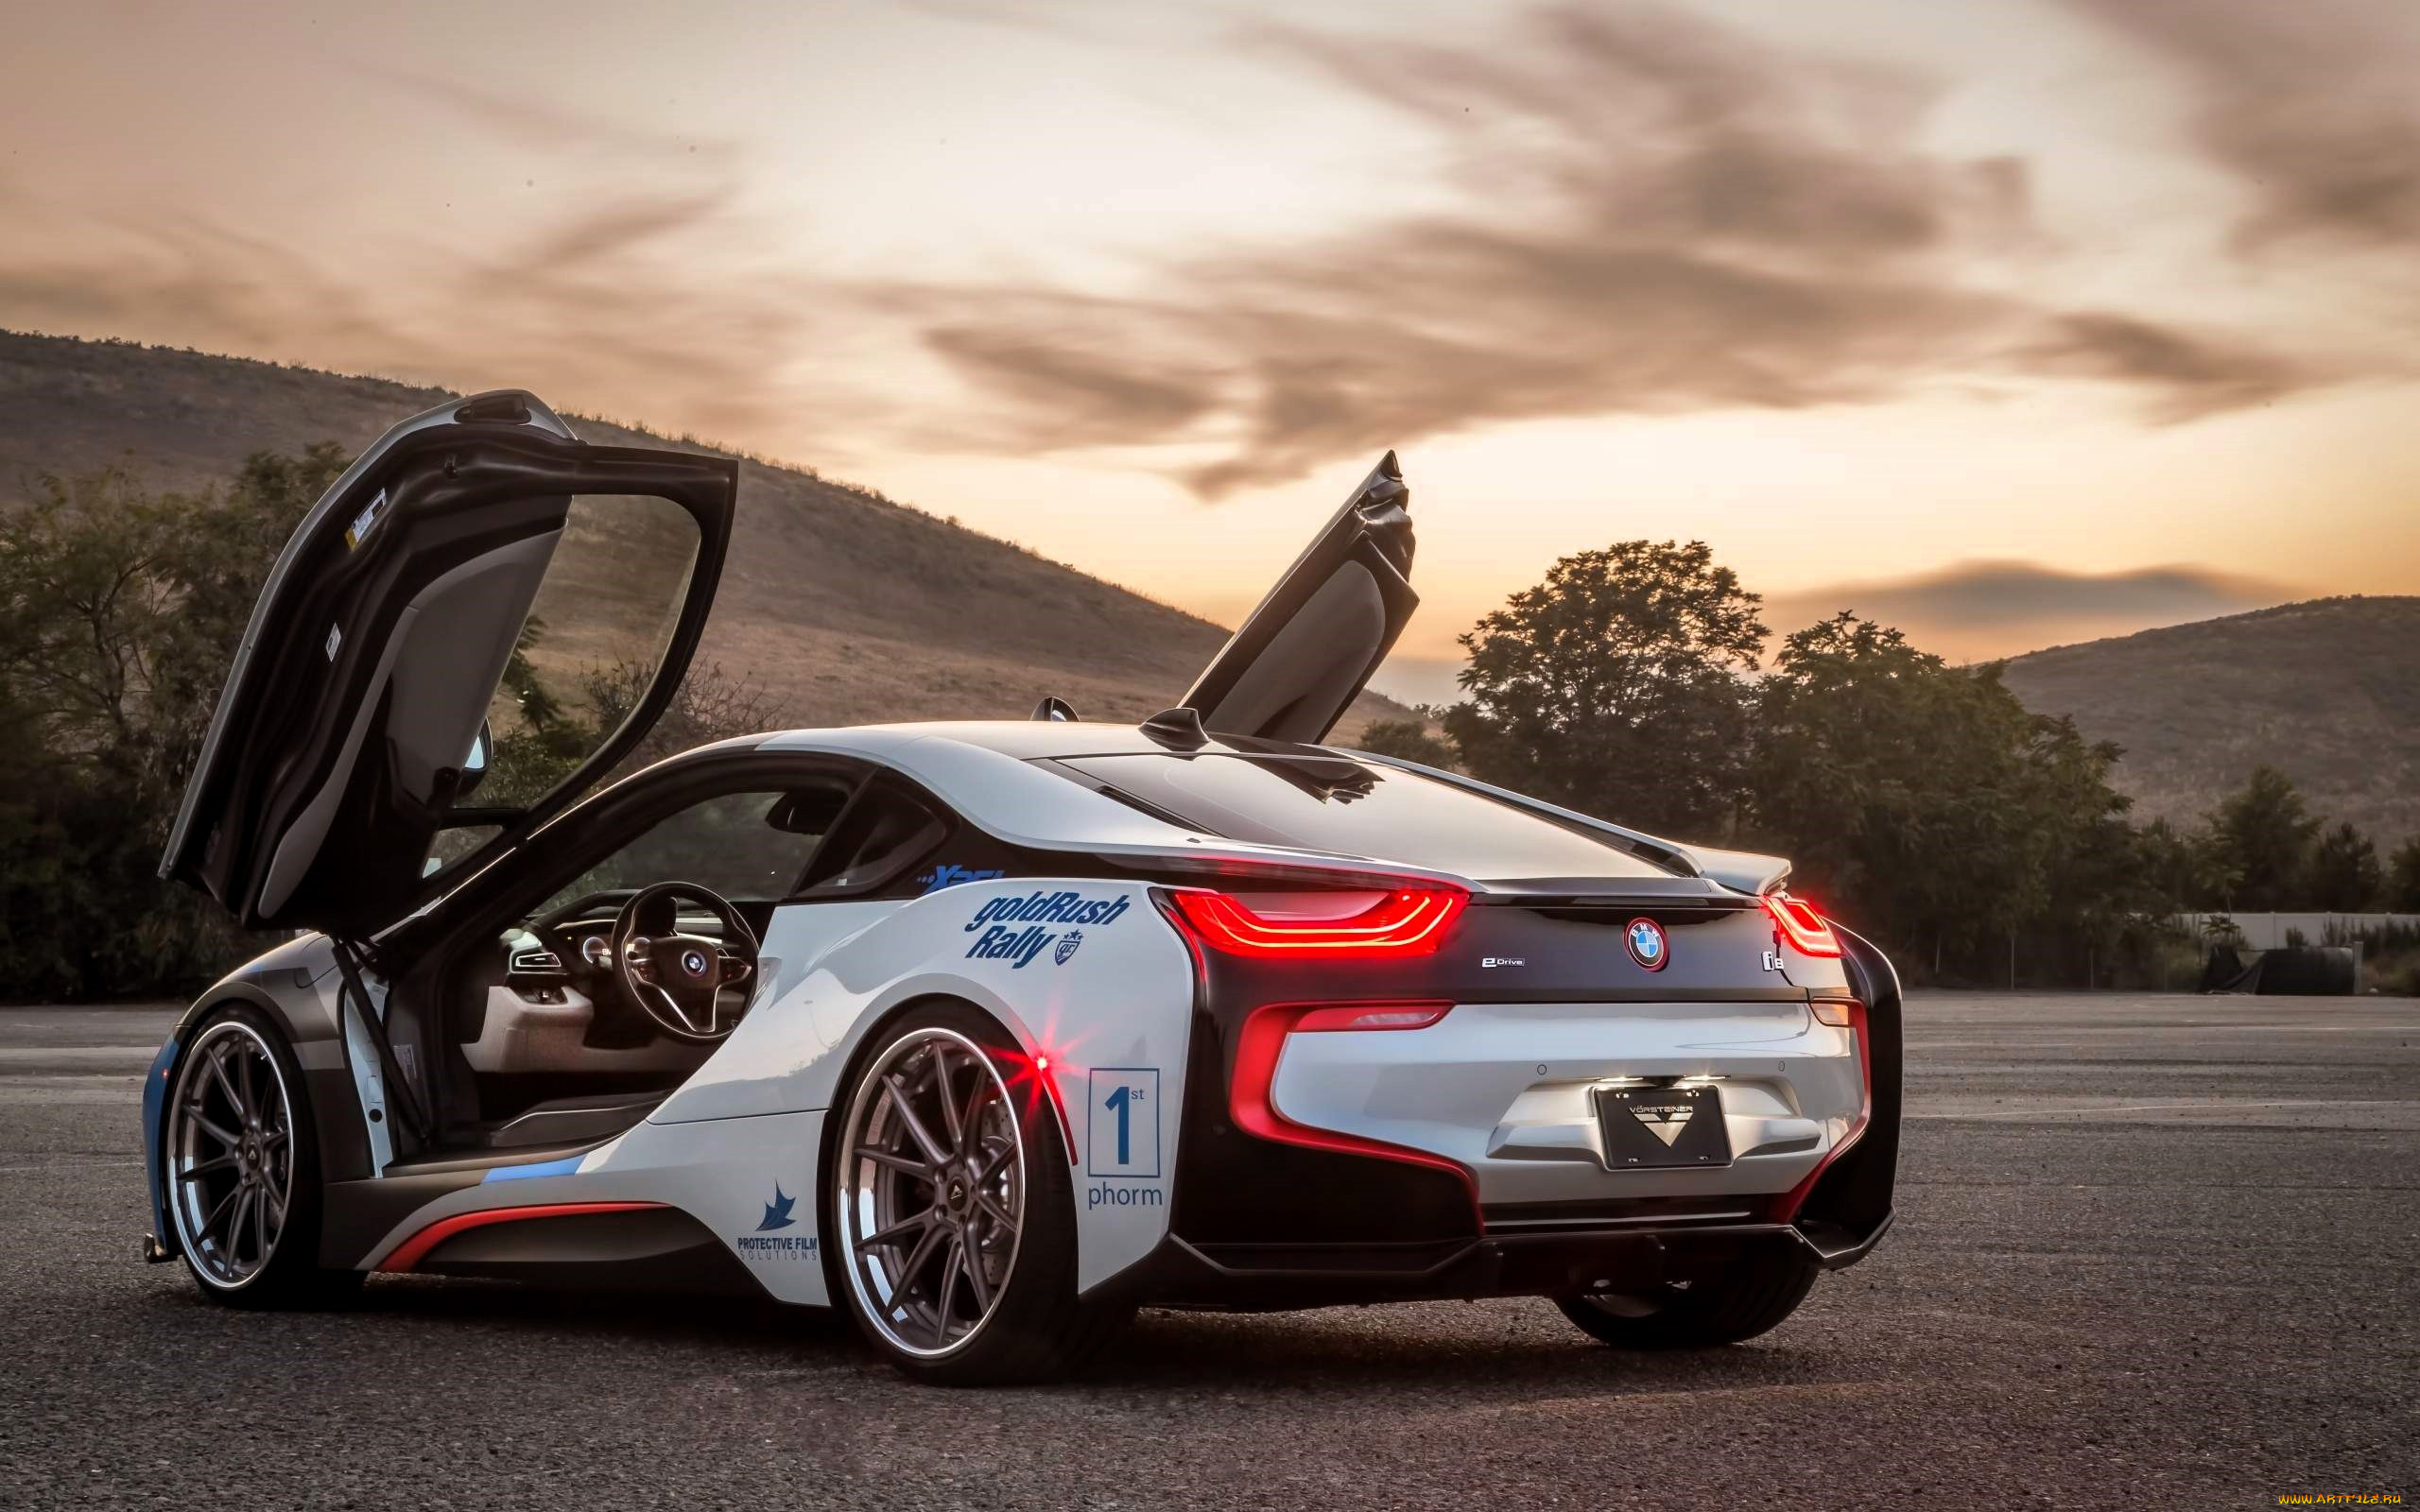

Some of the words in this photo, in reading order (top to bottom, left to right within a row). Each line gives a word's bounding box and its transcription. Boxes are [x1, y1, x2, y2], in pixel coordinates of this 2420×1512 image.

[964, 891, 1130, 932] goldRush
[1631, 922, 1660, 937] BMW
[965, 926, 1057, 969] Rally
[1088, 1181, 1163, 1211] phorm
[737, 1237, 793, 1250] PROTECTIVE
[795, 1237, 818, 1250] FILM
[739, 1250, 817, 1262] SOLUTIONS
